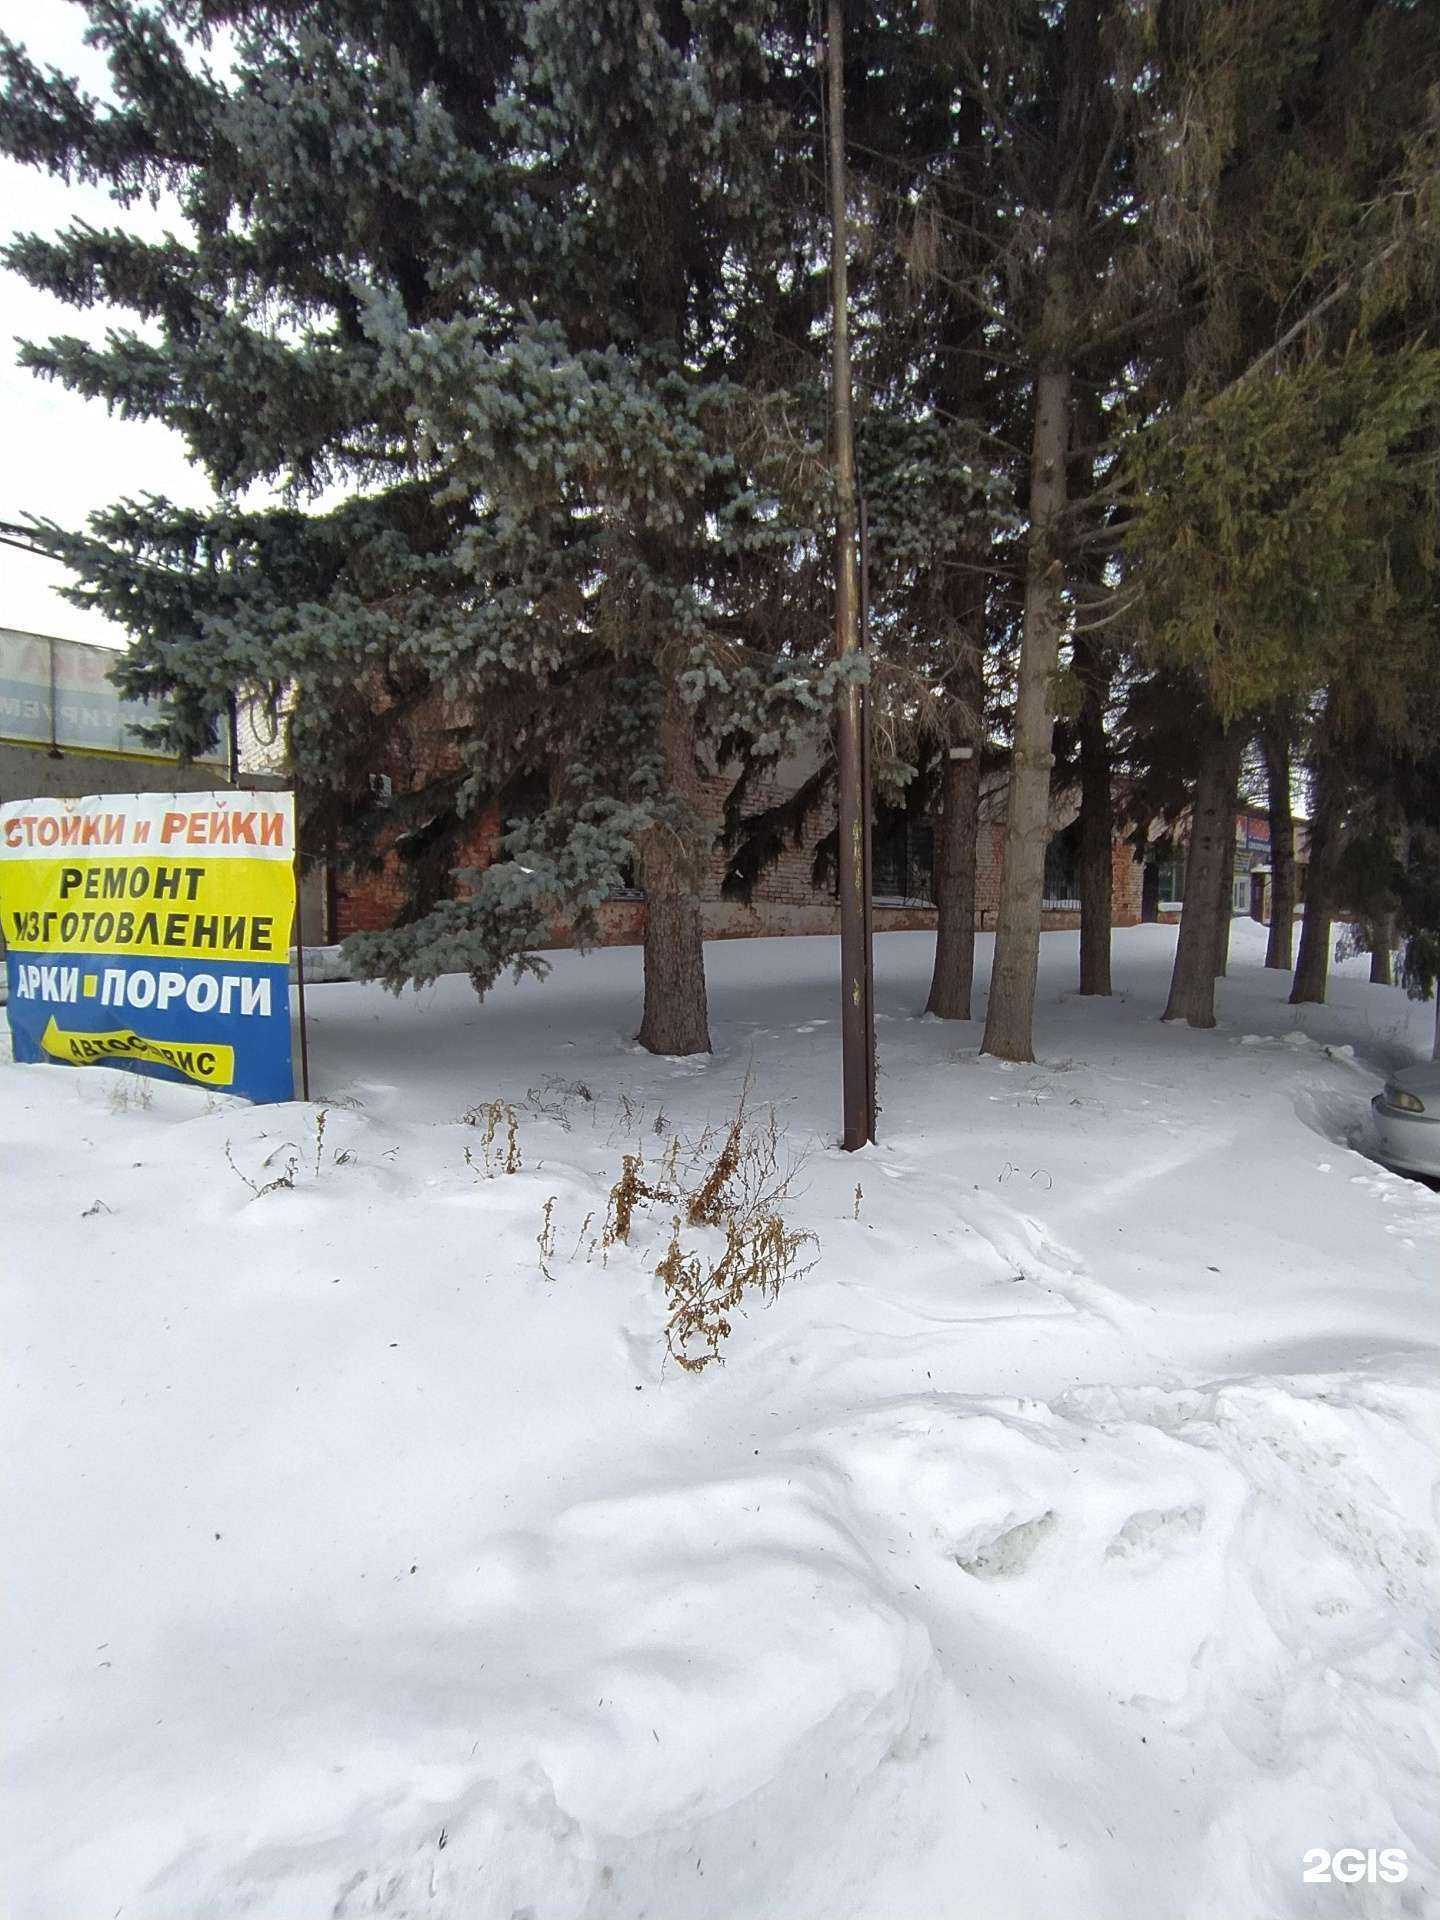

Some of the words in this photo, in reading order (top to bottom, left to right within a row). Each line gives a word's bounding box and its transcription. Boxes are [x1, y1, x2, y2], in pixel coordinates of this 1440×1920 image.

[4, 805, 127, 848] СТОЙКИ
[160, 801, 284, 847] РЕЙКИ
[60, 866, 205, 900] РЕМОНТ
[13, 911, 273, 951] ИЗГОТОВЛЕНИЕ
[17, 965, 79, 1003] АРКИ
[101, 968, 271, 1016] ПОРОГИ
[69, 1036, 216, 1074] АВТОСВИС
